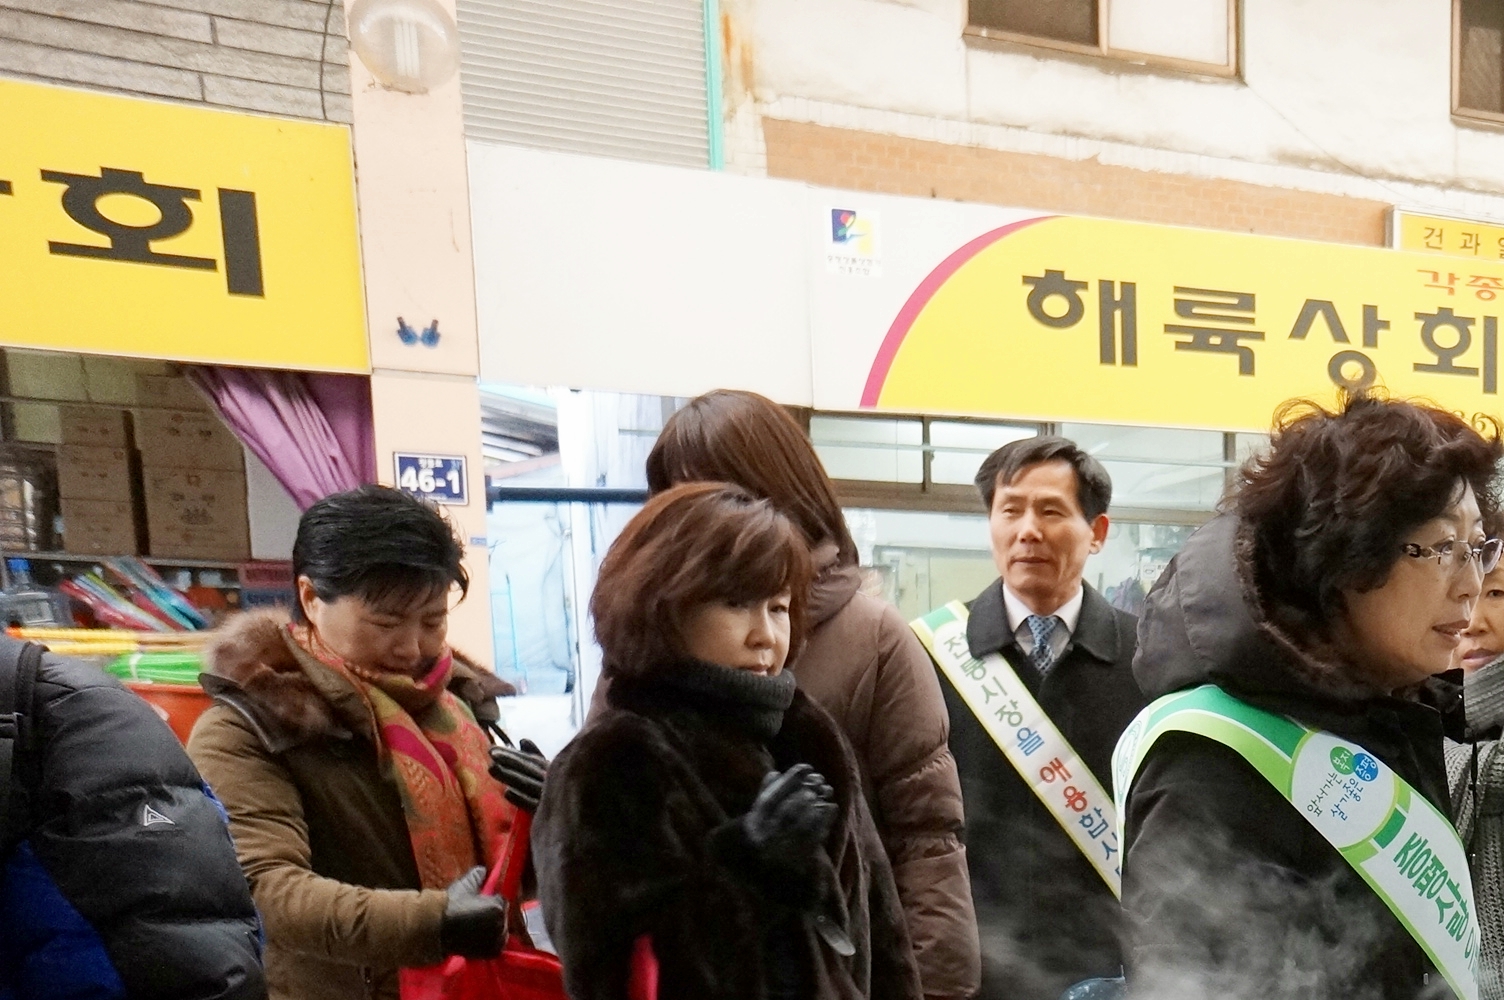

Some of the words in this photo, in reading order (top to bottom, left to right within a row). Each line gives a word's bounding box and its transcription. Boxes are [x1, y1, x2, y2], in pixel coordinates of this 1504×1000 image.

[0, 165, 266, 298] 회
[400, 465, 460, 494] 46-1
[1332, 750, 1351, 771] 복지
[1355, 755, 1378, 781] 증평
[1039, 757, 1123, 877] 애용합시
